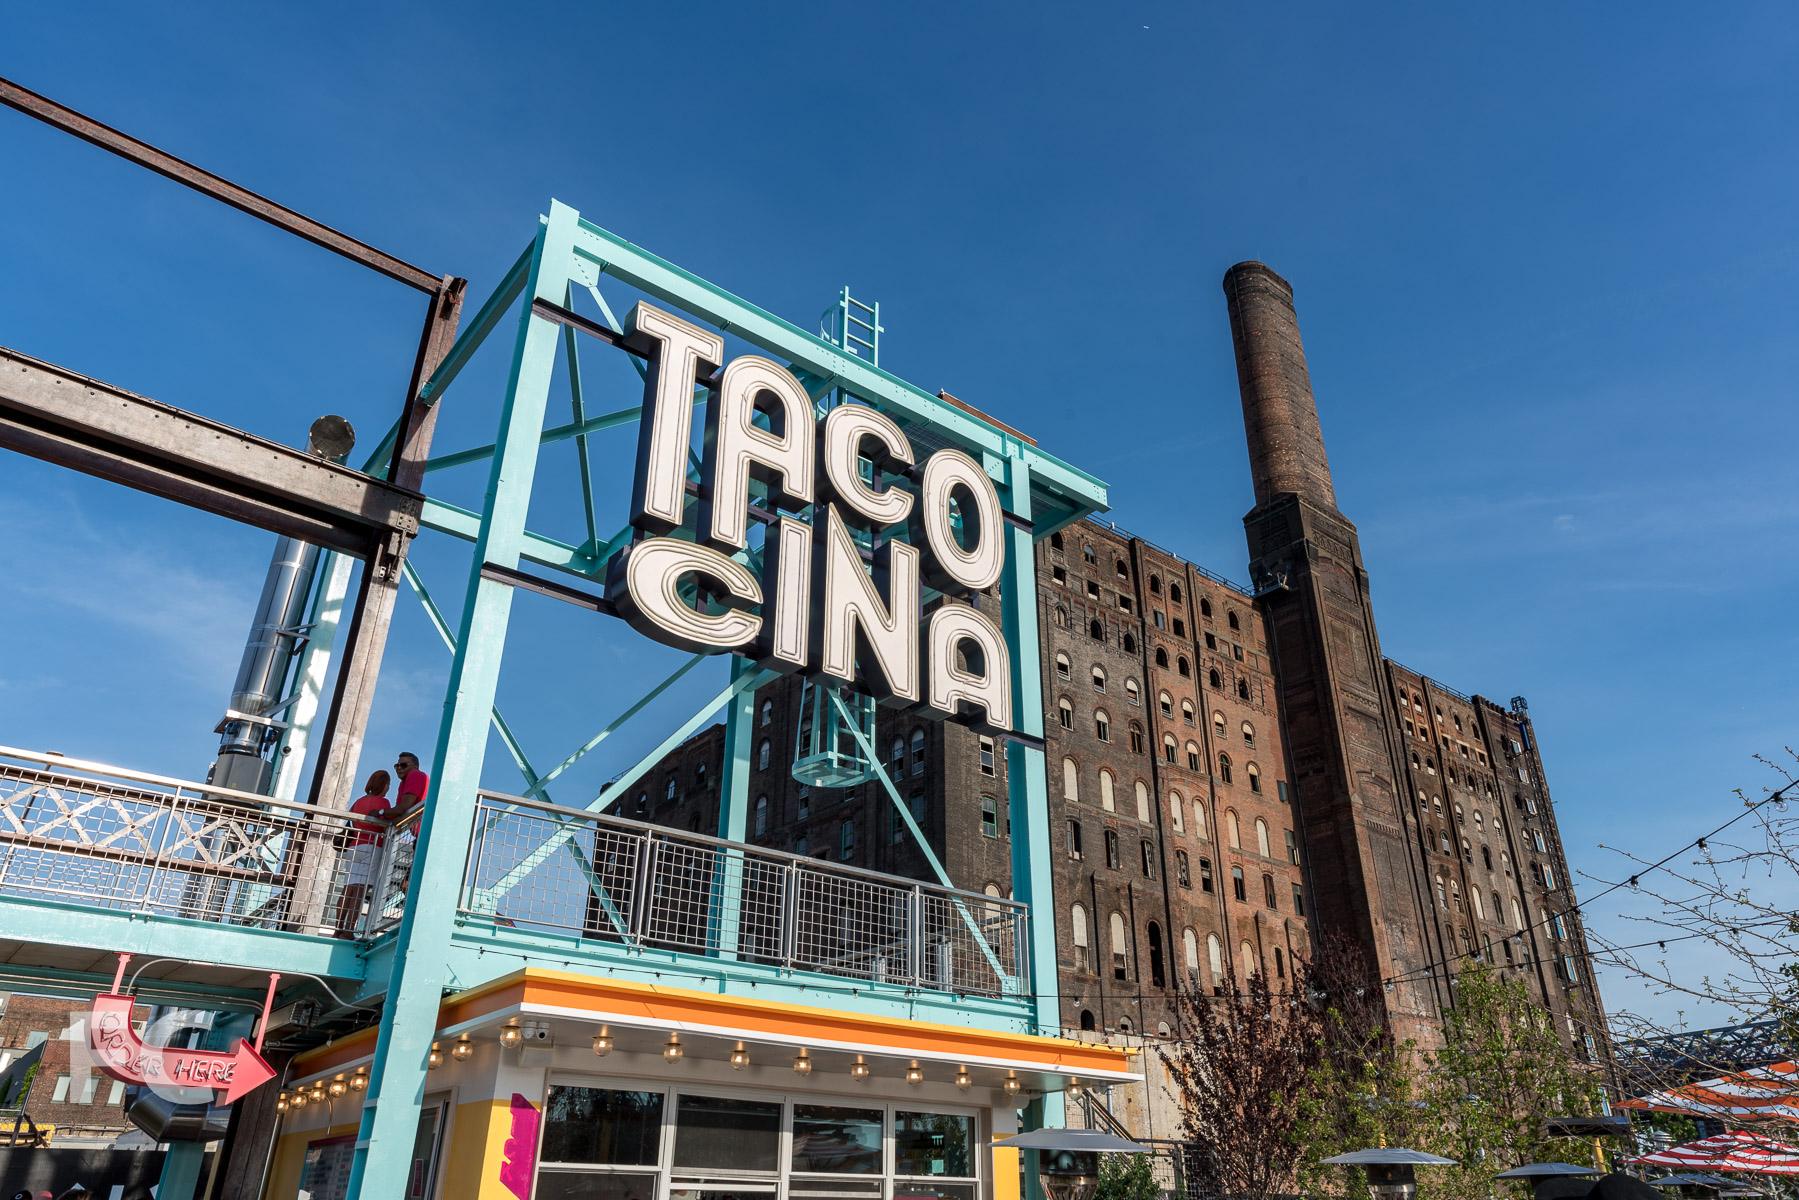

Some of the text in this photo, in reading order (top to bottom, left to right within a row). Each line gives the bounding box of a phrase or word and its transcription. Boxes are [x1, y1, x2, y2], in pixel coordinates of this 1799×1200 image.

[630, 300, 1005, 592] TACO
[623, 503, 1013, 732] CINA
[100, 1011, 238, 1083] ORDER HERE
